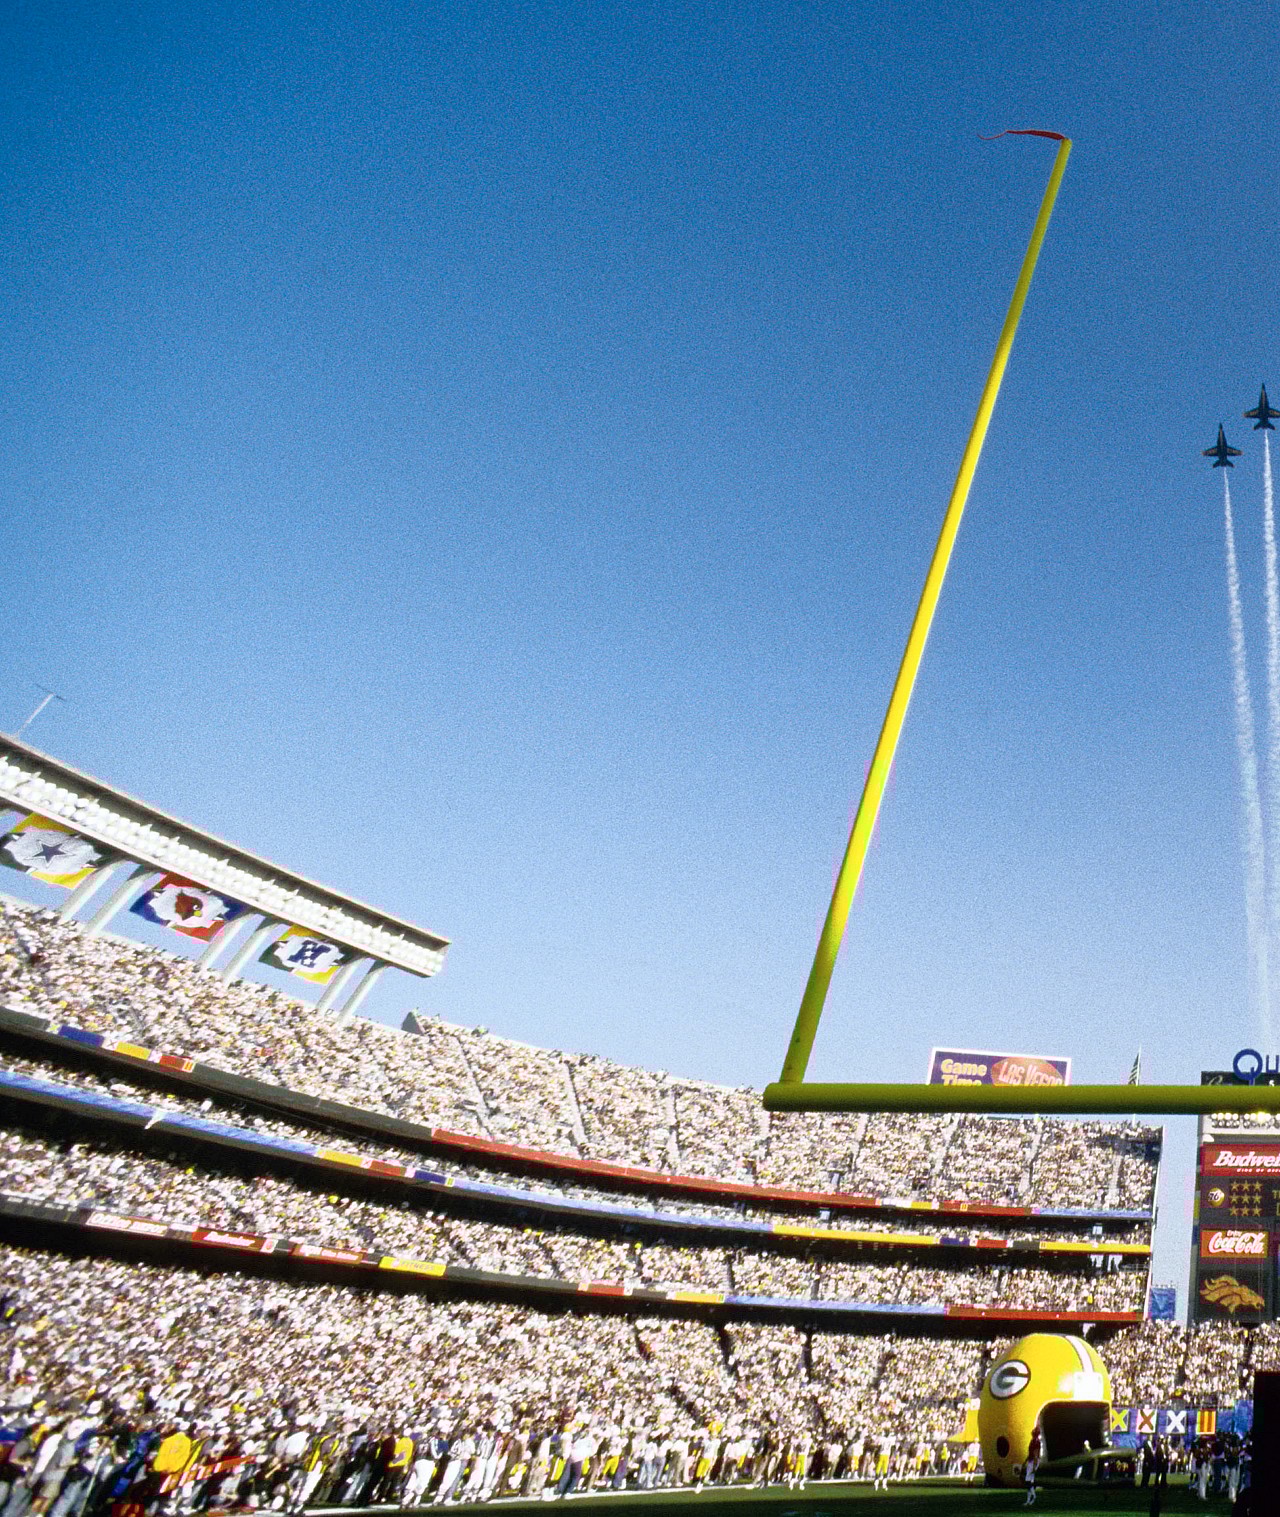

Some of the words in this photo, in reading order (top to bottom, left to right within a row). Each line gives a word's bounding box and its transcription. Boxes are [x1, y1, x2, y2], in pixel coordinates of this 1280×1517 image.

[941, 1059, 987, 1076] Game
[1208, 1191, 1220, 1202] 76
[990, 1360, 1031, 1399] G
